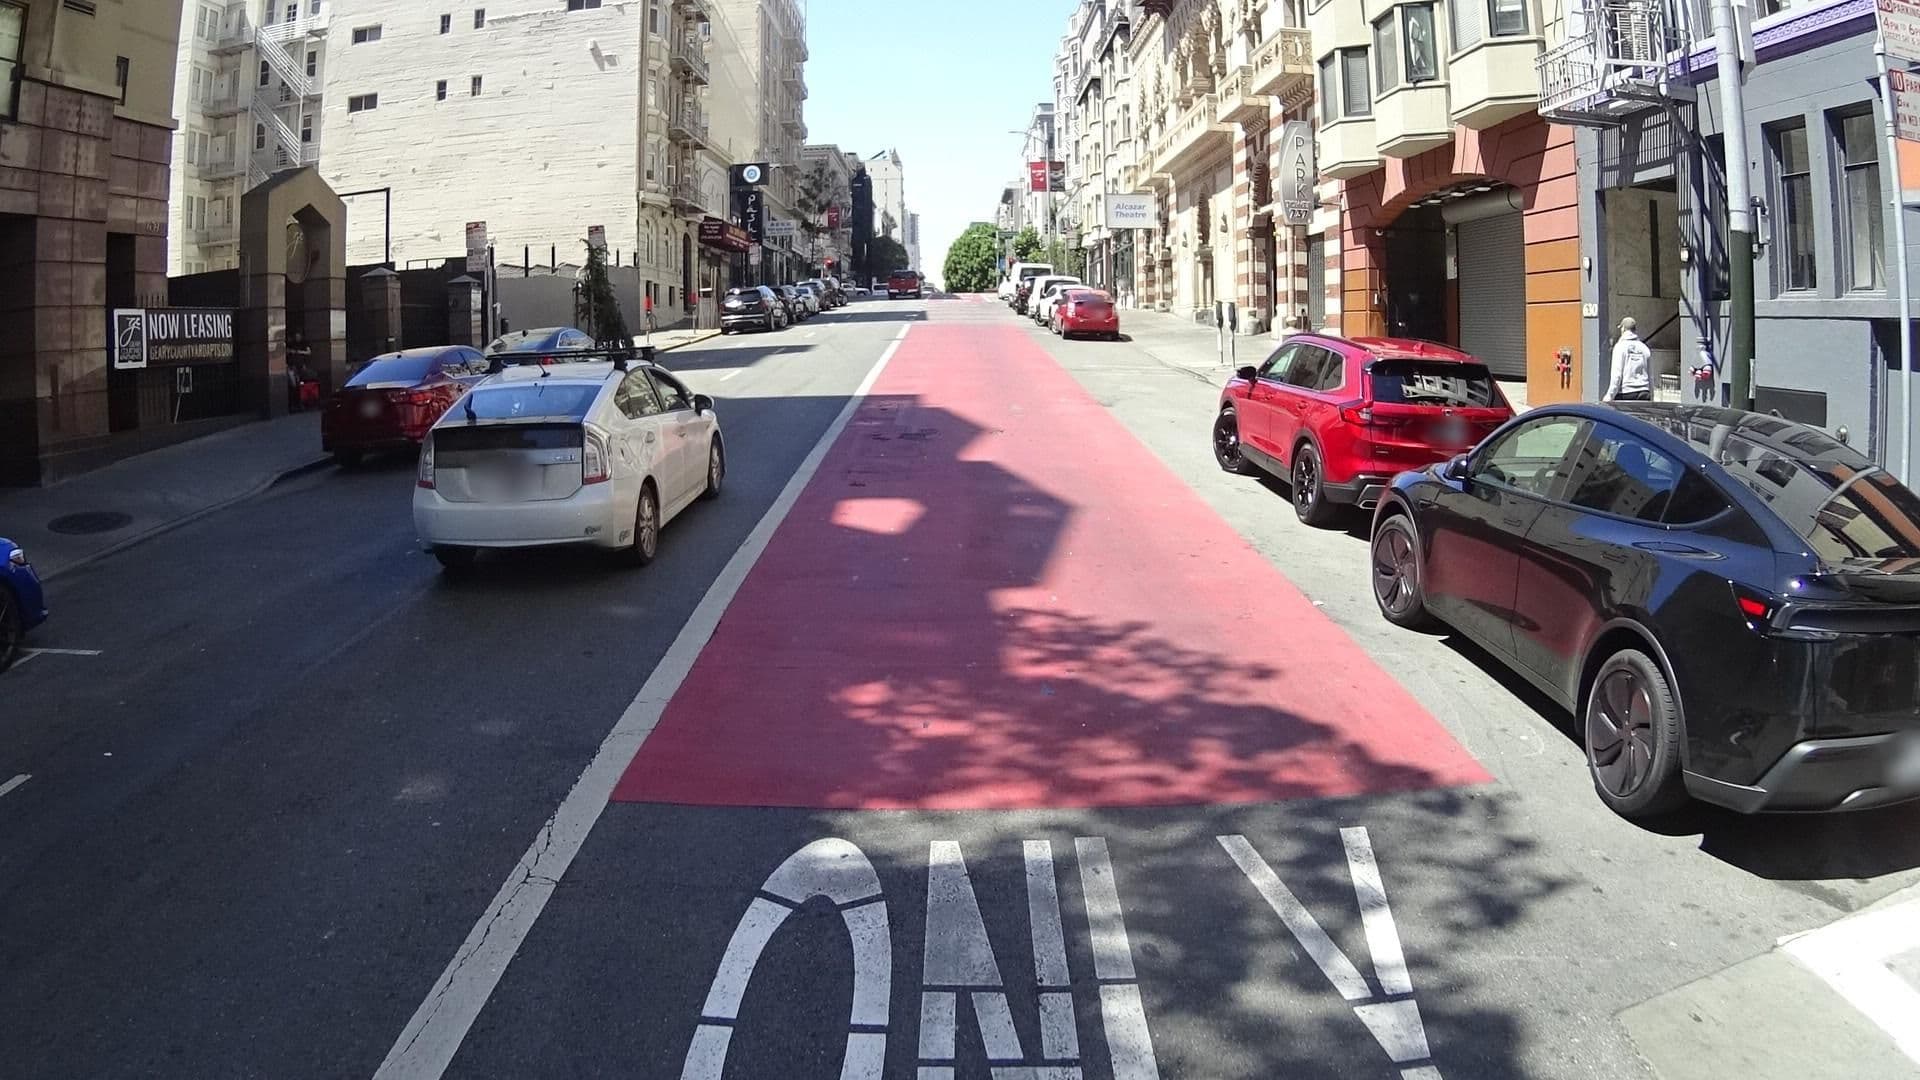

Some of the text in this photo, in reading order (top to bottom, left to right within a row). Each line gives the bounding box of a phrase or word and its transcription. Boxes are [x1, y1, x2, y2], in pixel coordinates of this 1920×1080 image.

[1292, 136, 1307, 199] PARK
[1289, 208, 1308, 218] 737
[149, 313, 232, 340] NOW LEASING
